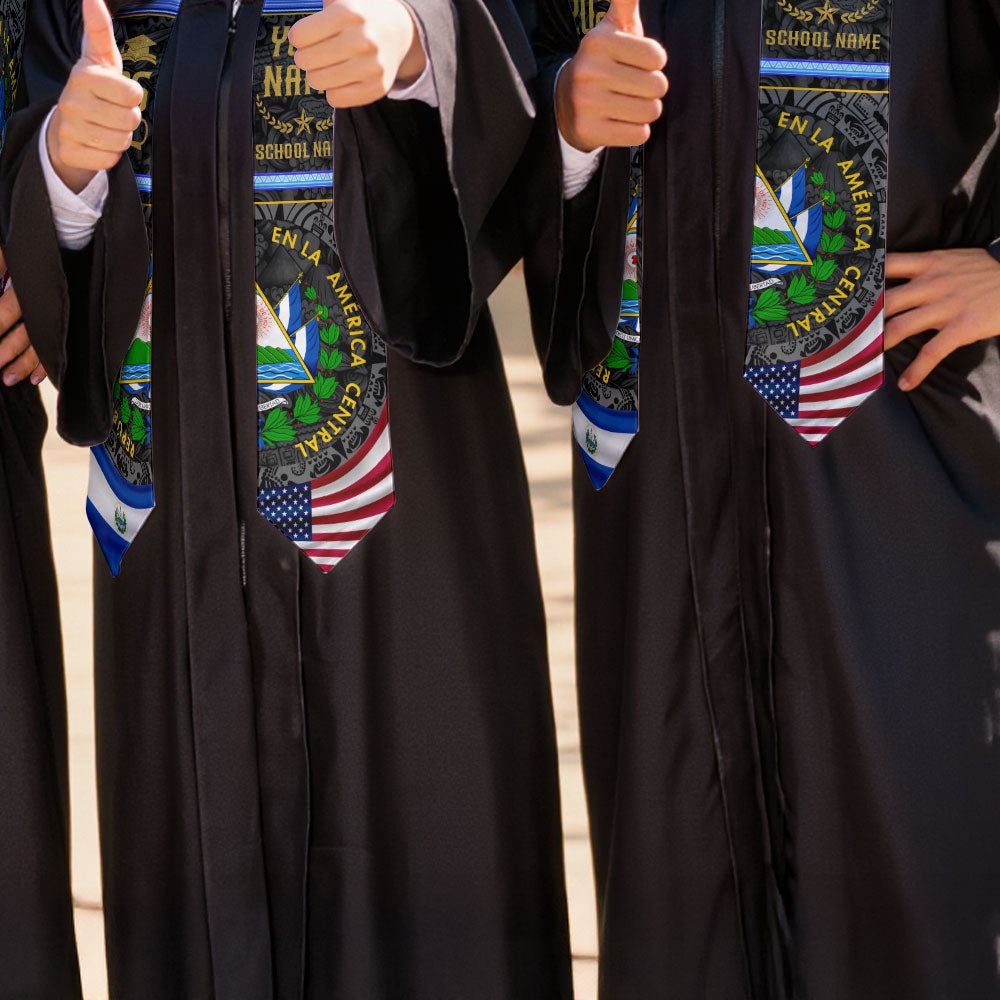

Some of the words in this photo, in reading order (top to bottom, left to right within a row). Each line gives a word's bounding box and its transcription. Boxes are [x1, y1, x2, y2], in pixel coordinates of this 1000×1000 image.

[765, 29, 831, 49] SCHOOL
[835, 31, 881, 50] NAME
[778, 111, 809, 135] EN
[255, 143, 310, 161] SCHOOL
[313, 141, 331, 157] NA
[811, 126, 835, 153] LA
[837, 159, 873, 252] AMÉRICA
[271, 226, 298, 249] EN
[301, 240, 322, 267] LA
[786, 266, 862, 338] CENTRAL
[294, 383, 362, 458] CENTRAL
